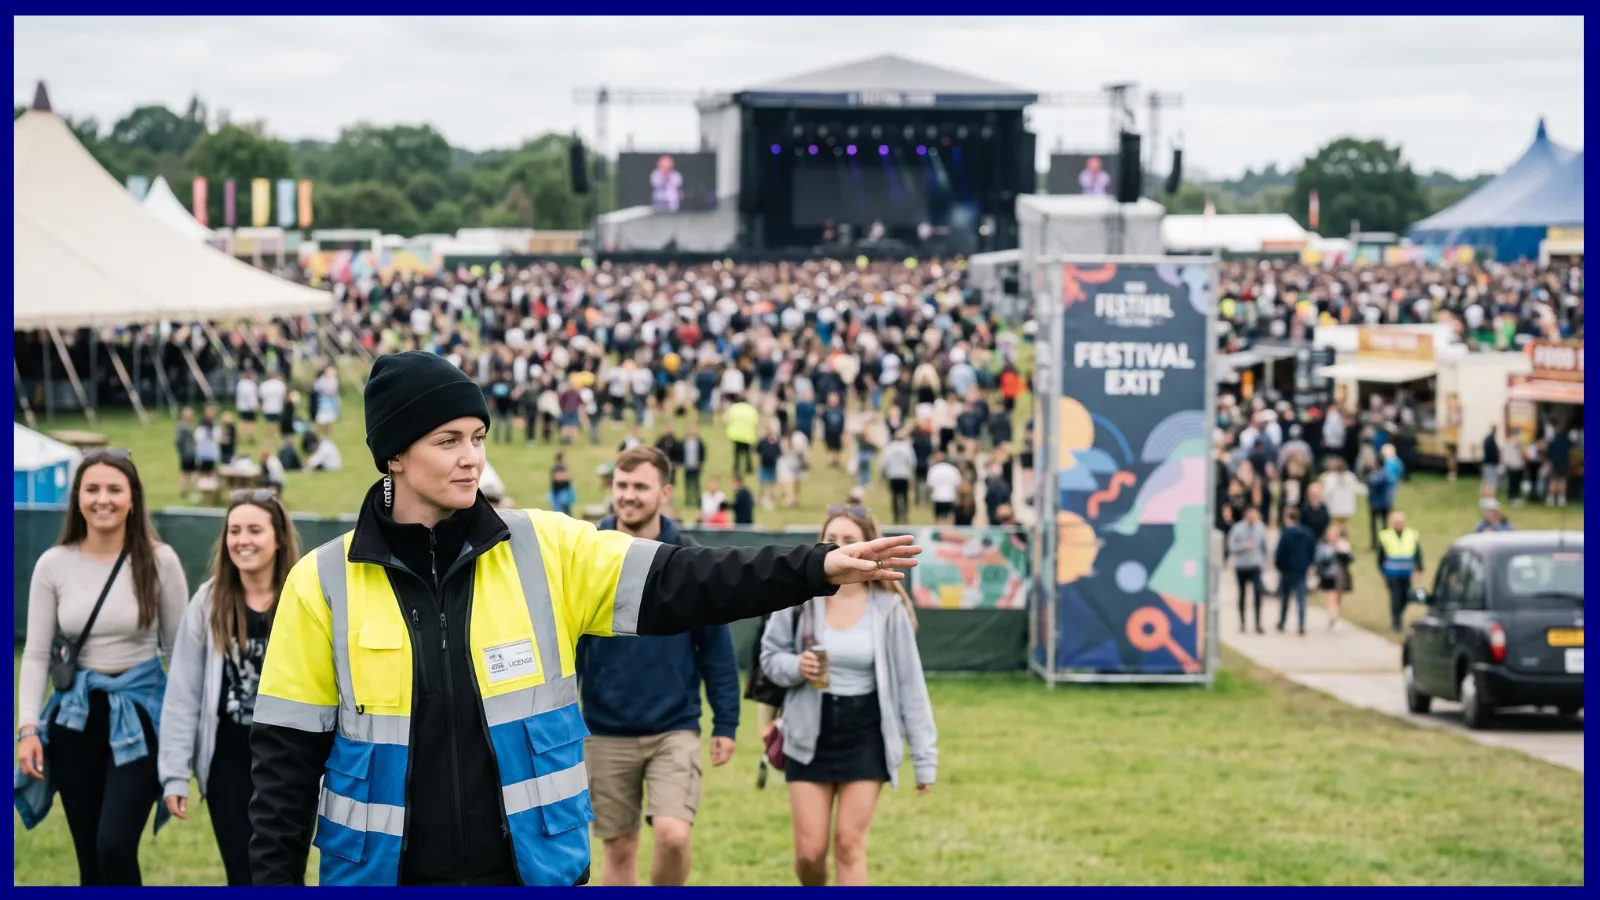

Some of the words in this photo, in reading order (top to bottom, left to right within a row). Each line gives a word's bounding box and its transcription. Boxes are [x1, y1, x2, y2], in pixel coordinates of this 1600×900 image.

[1074, 341, 1196, 369] FESTIVAL
[1104, 369, 1165, 396] EXIT
[508, 657, 533, 668] LICENSE
